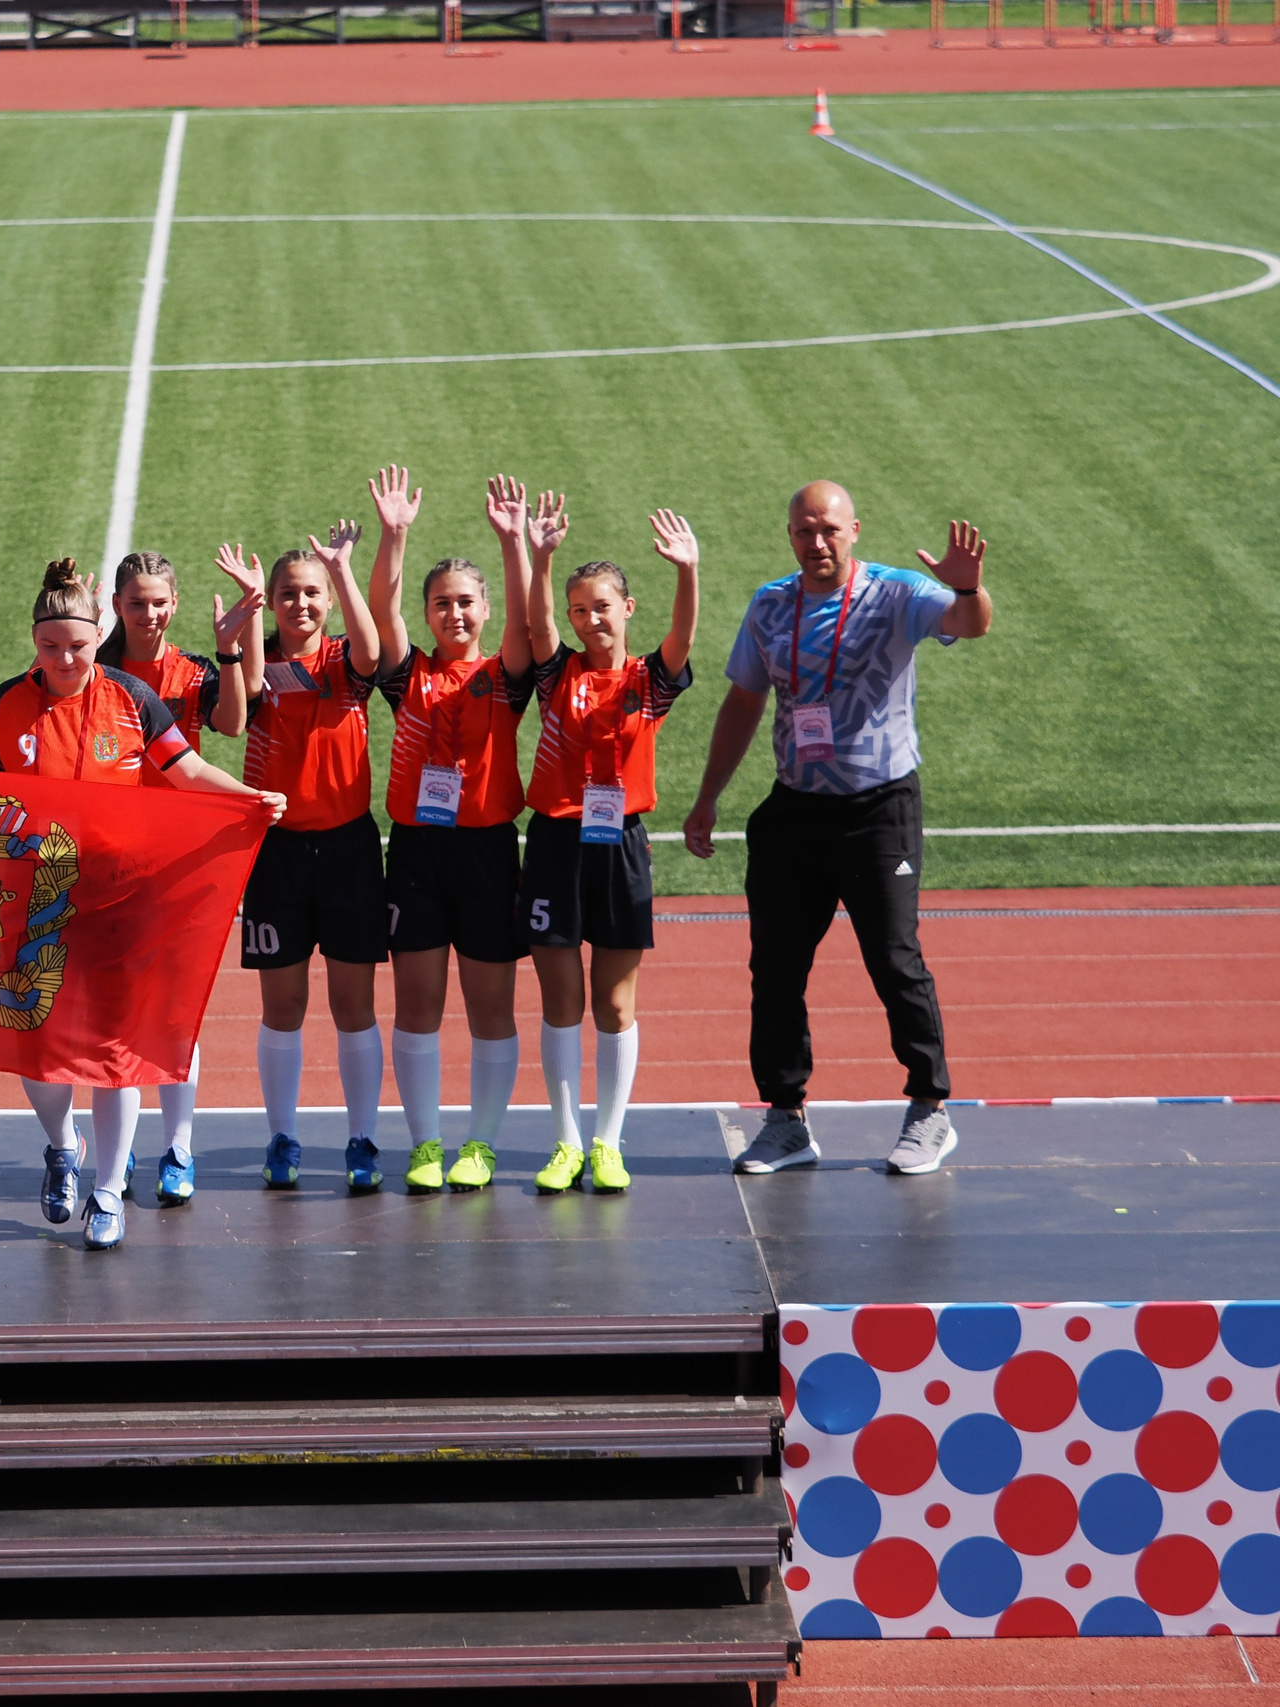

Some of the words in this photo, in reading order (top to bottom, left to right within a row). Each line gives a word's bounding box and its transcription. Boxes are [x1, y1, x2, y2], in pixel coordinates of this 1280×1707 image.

[17, 733, 38, 767] 9
[420, 811, 452, 822] УЧАСТНИК
[585, 831, 618, 840] УЧАСТНИК
[387, 902, 401, 936] 7
[529, 898, 551, 932] 5
[245, 918, 280, 955] 10
